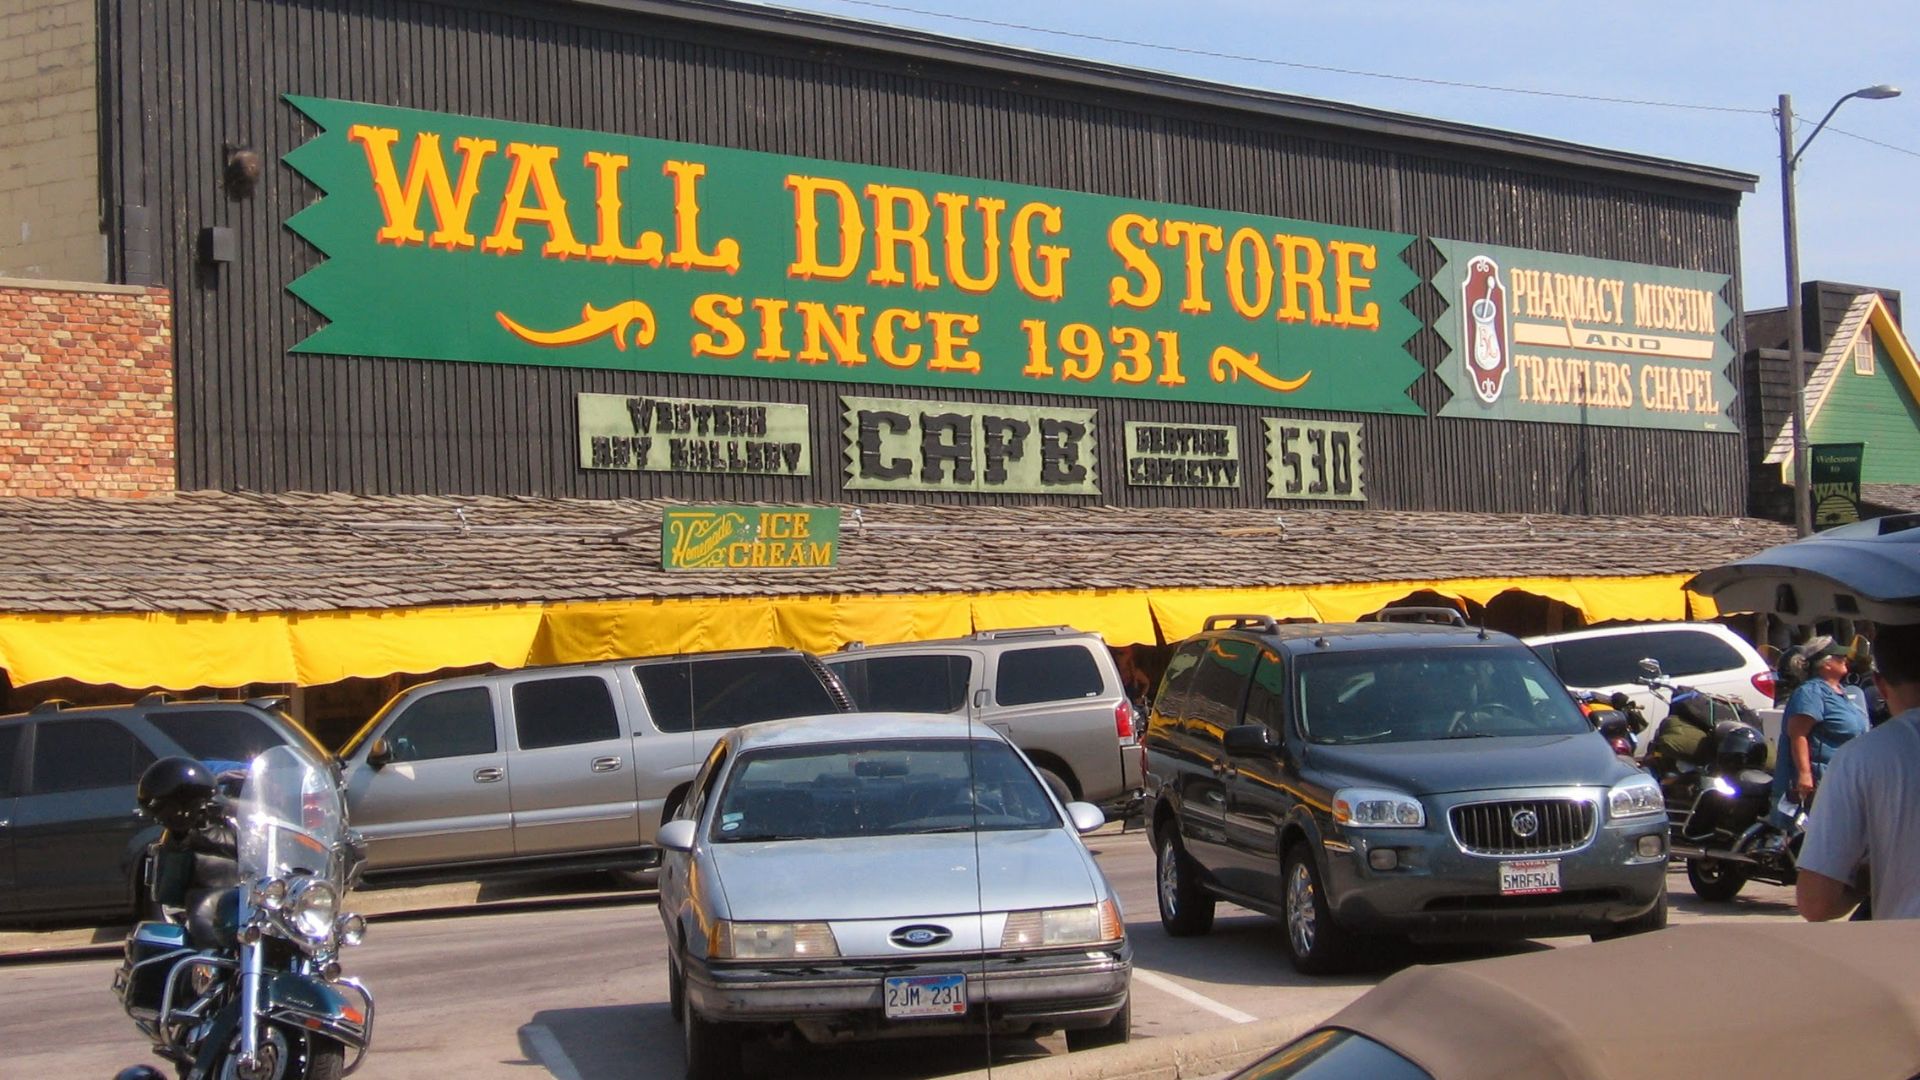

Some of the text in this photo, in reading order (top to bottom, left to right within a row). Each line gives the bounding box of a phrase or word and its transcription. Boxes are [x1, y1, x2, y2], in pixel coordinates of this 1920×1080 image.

[348, 124, 1380, 330] WALL DRUG STORE
[1510, 267, 1716, 335] PHARMACY MUSEUM
[691, 293, 1187, 387] SINCE 1931
[1585, 333, 1662, 351] AND
[1514, 354, 1719, 415] TRAVELERS CHAPEL
[626, 397, 767, 437] WESTERN
[591, 435, 802, 473] ART GALLERY
[856, 409, 1088, 486] CAFE
[1135, 425, 1230, 456] SEATING
[1130, 457, 1238, 485] CAPACITY
[1280, 426, 1352, 495] 530
[1812, 481, 1858, 504] WALL
[759, 512, 811, 540] ICE
[728, 541, 833, 568] CREAM
[888, 985, 962, 1007] 2JM 231
